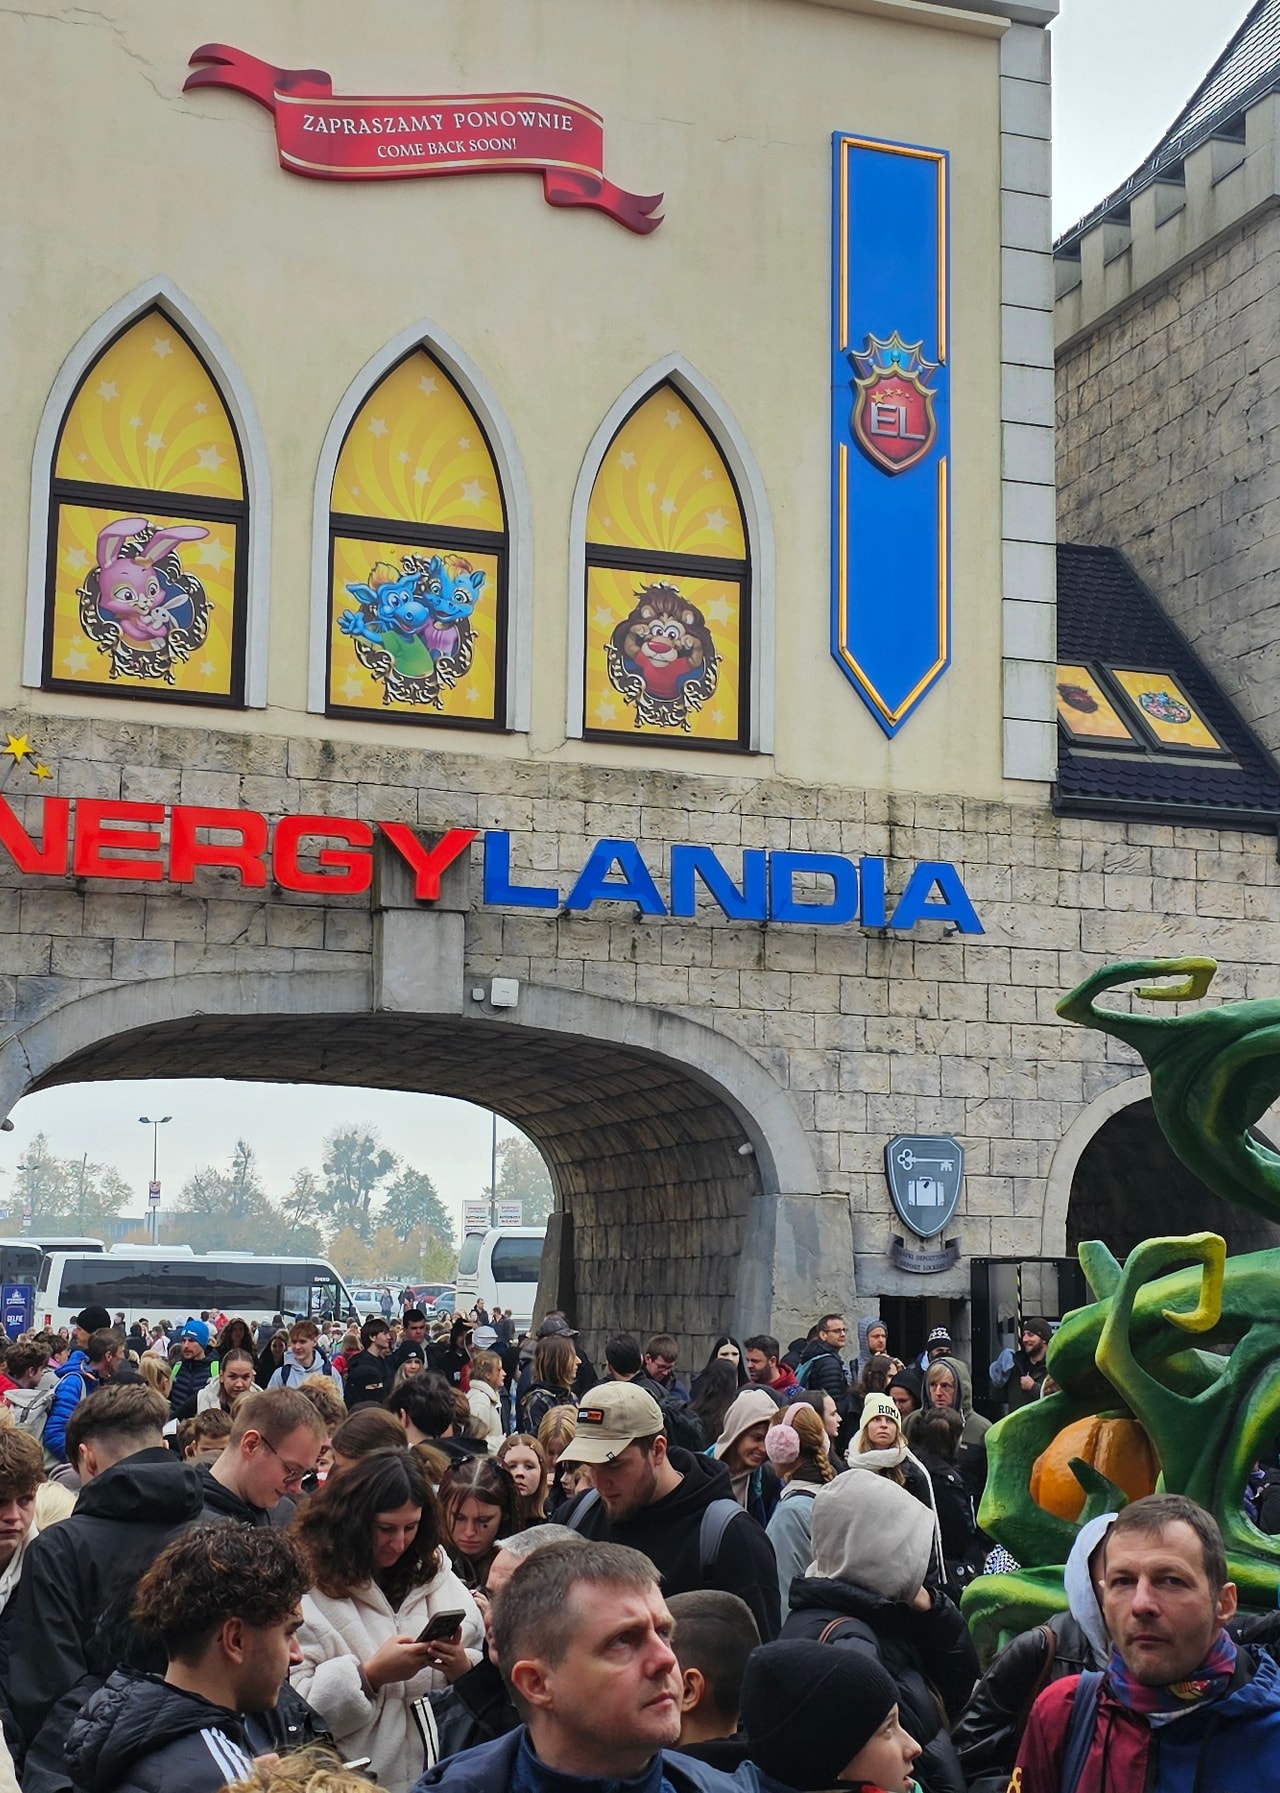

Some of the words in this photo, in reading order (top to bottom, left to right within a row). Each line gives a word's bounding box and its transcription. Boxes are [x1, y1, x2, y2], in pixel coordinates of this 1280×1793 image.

[303, 113, 443, 135] ZAPRASZAMY
[454, 110, 574, 131] PONOWNIE
[377, 143, 422, 158] COME
[427, 140, 466, 155] BACK
[469, 137, 517, 152] SOON!
[871, 402, 926, 440] EL
